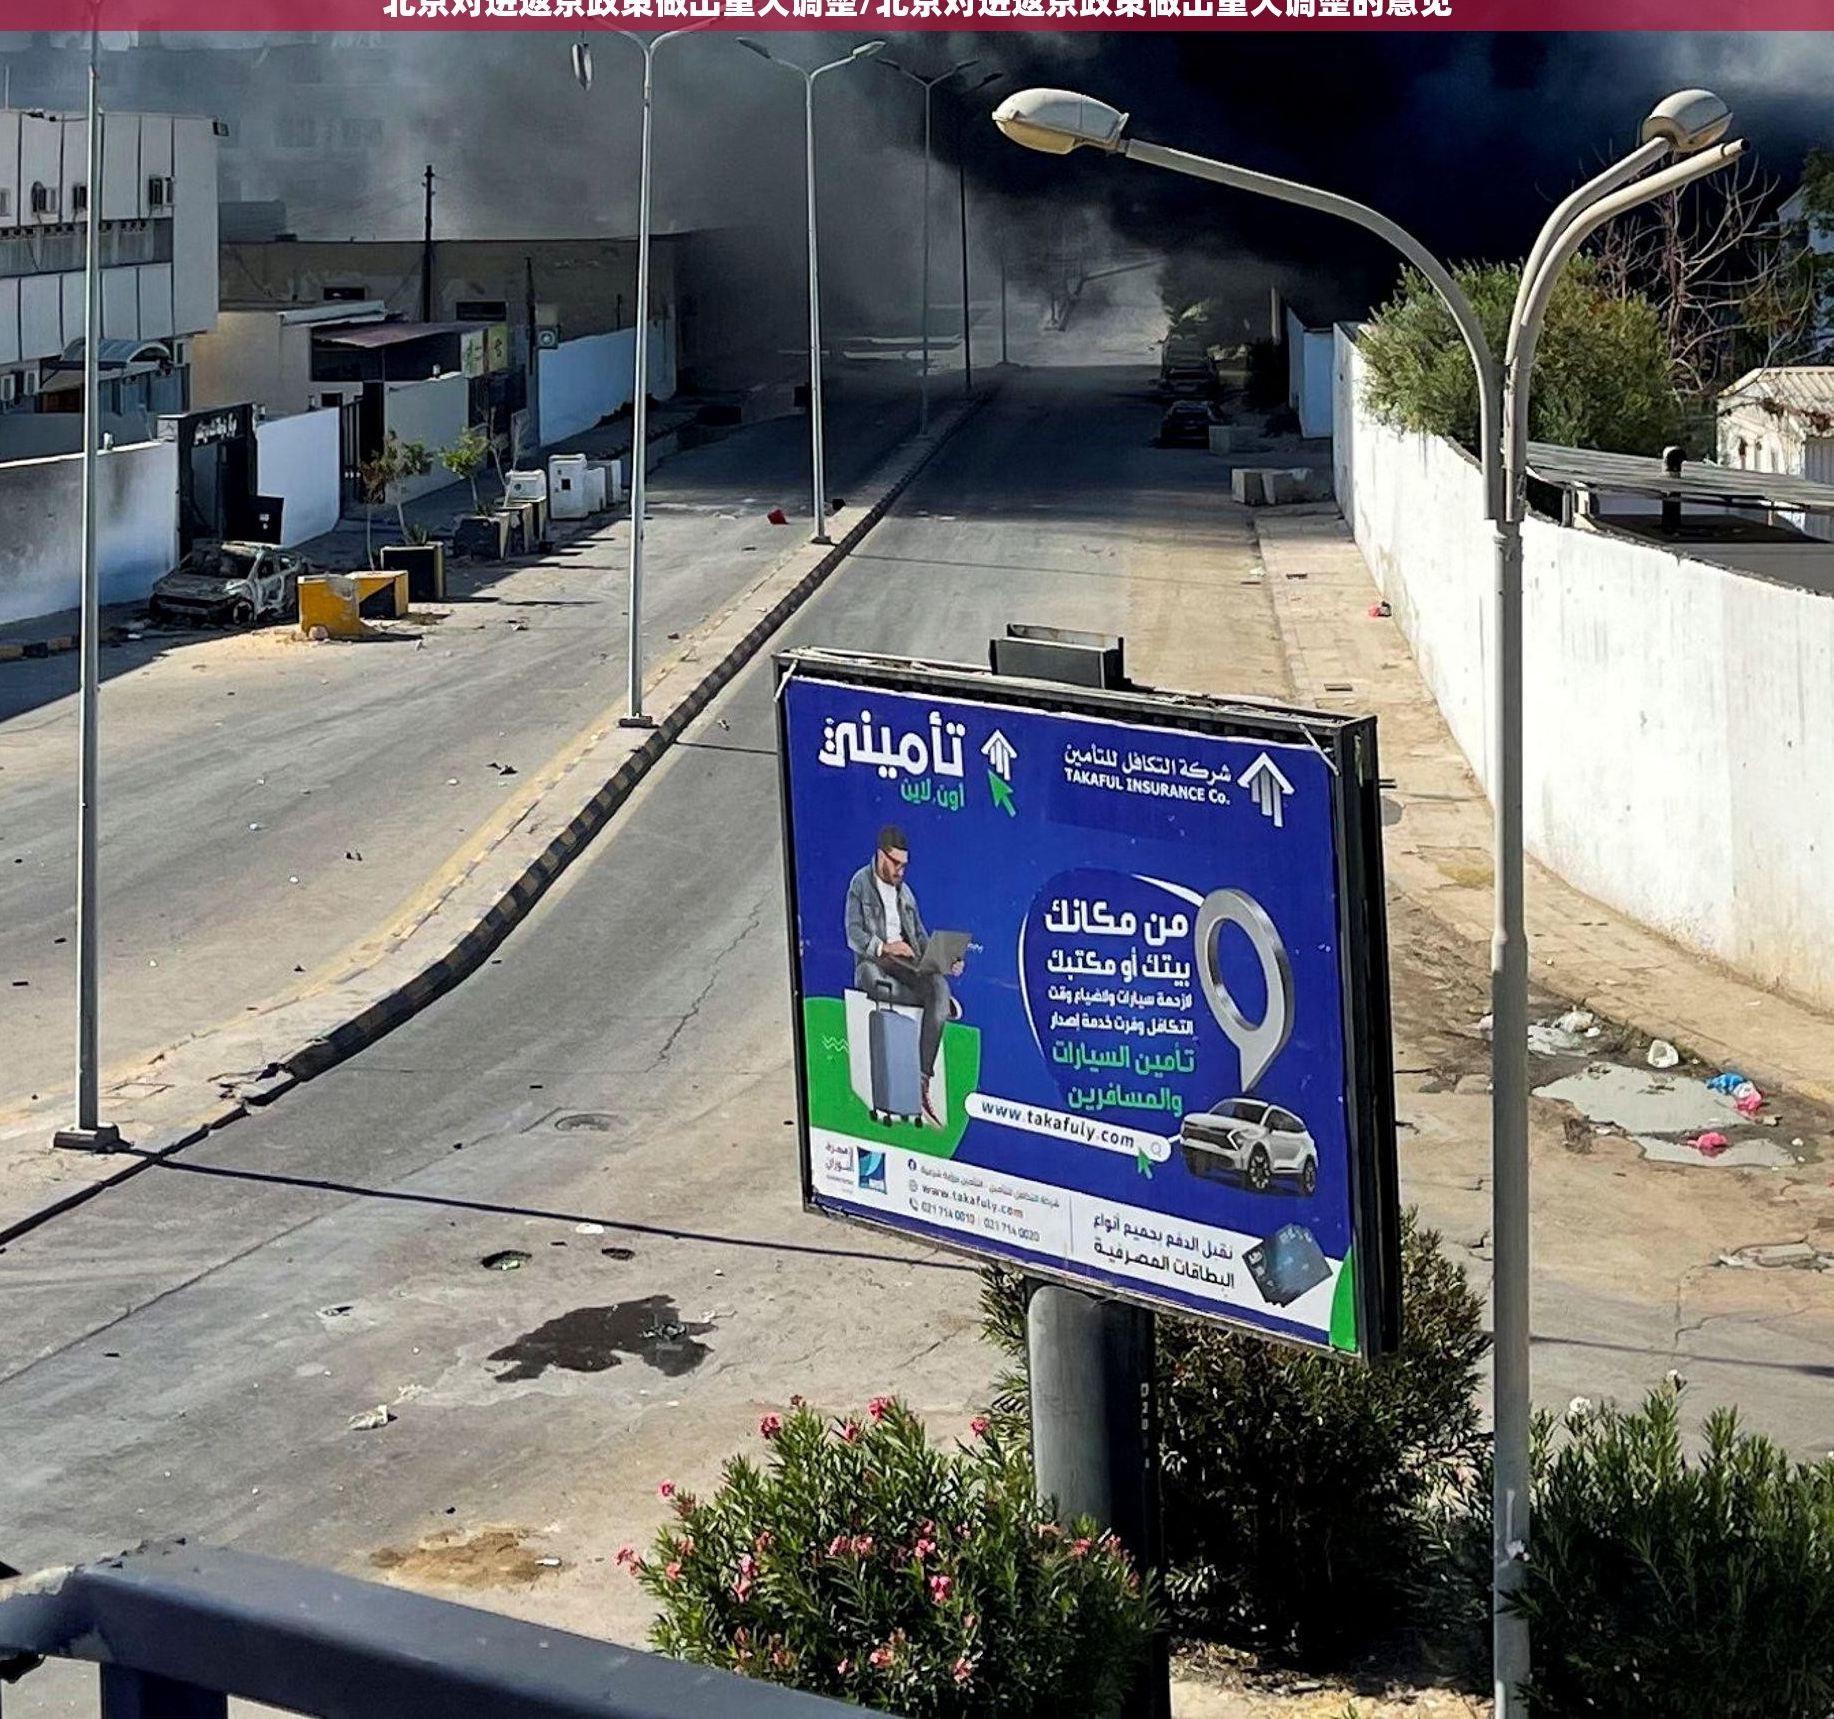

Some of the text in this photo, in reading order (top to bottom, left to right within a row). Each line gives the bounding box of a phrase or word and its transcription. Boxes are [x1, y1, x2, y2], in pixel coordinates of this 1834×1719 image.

[1064, 743, 1232, 786] شركة التكافل للتأمين
[1064, 767, 1231, 805] TAKAFUL INSURANCE Co.
[1044, 898, 1189, 946] من مكانك
[1047, 946, 1191, 987] بيتك أو مكتبك
[1048, 985, 1073, 1004] وقت
[1116, 990, 1155, 1009] سيارات
[1081, 1012, 1113, 1030] خدمة
[1146, 1016, 1194, 1036] التكافل
[1052, 1040, 1195, 1078] تأمين السيارات
[1067, 1082, 1183, 1118] والمسافرين
[981, 1100, 1135, 1149] www.takafuly.com
[1166, 1232, 1199, 1251] الدفع
[1094, 1236, 1236, 1292] البطاقات المصرفية
